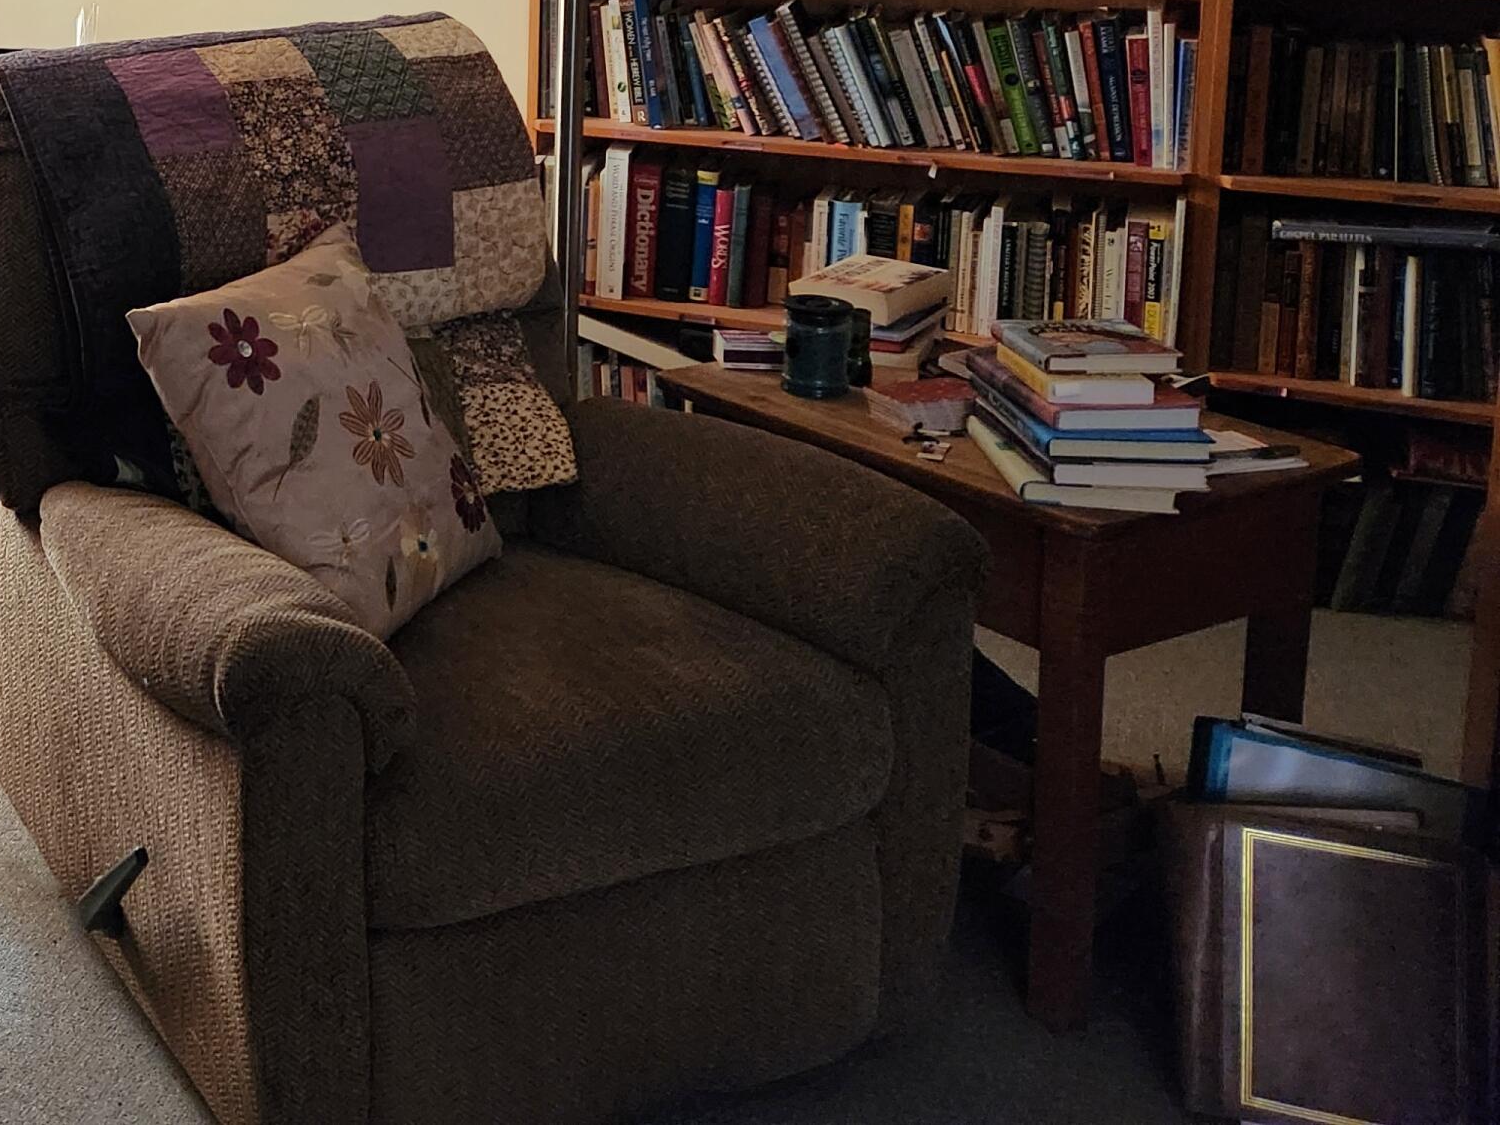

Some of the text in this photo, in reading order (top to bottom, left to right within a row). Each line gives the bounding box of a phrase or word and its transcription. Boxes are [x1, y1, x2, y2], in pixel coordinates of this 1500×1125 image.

[623, 12, 636, 44] WOMEN
[994, 33, 1014, 70] DECISIVE
[629, 57, 642, 86] HEBREW
[633, 86, 644, 103] BIBLE
[1108, 75, 1122, 142] AGAINST DEPRESSION
[607, 163, 620, 272] WORD AND PHRASE ORIGINS
[836, 212, 848, 247] Favorite
[629, 188, 656, 292] Dictionary
[710, 223, 730, 270] WORDS
[1281, 230, 1372, 243] GOSPEL PARALLELS
[1147, 241, 1158, 280] PowerPoint
[1147, 282, 1156, 299] 2003
